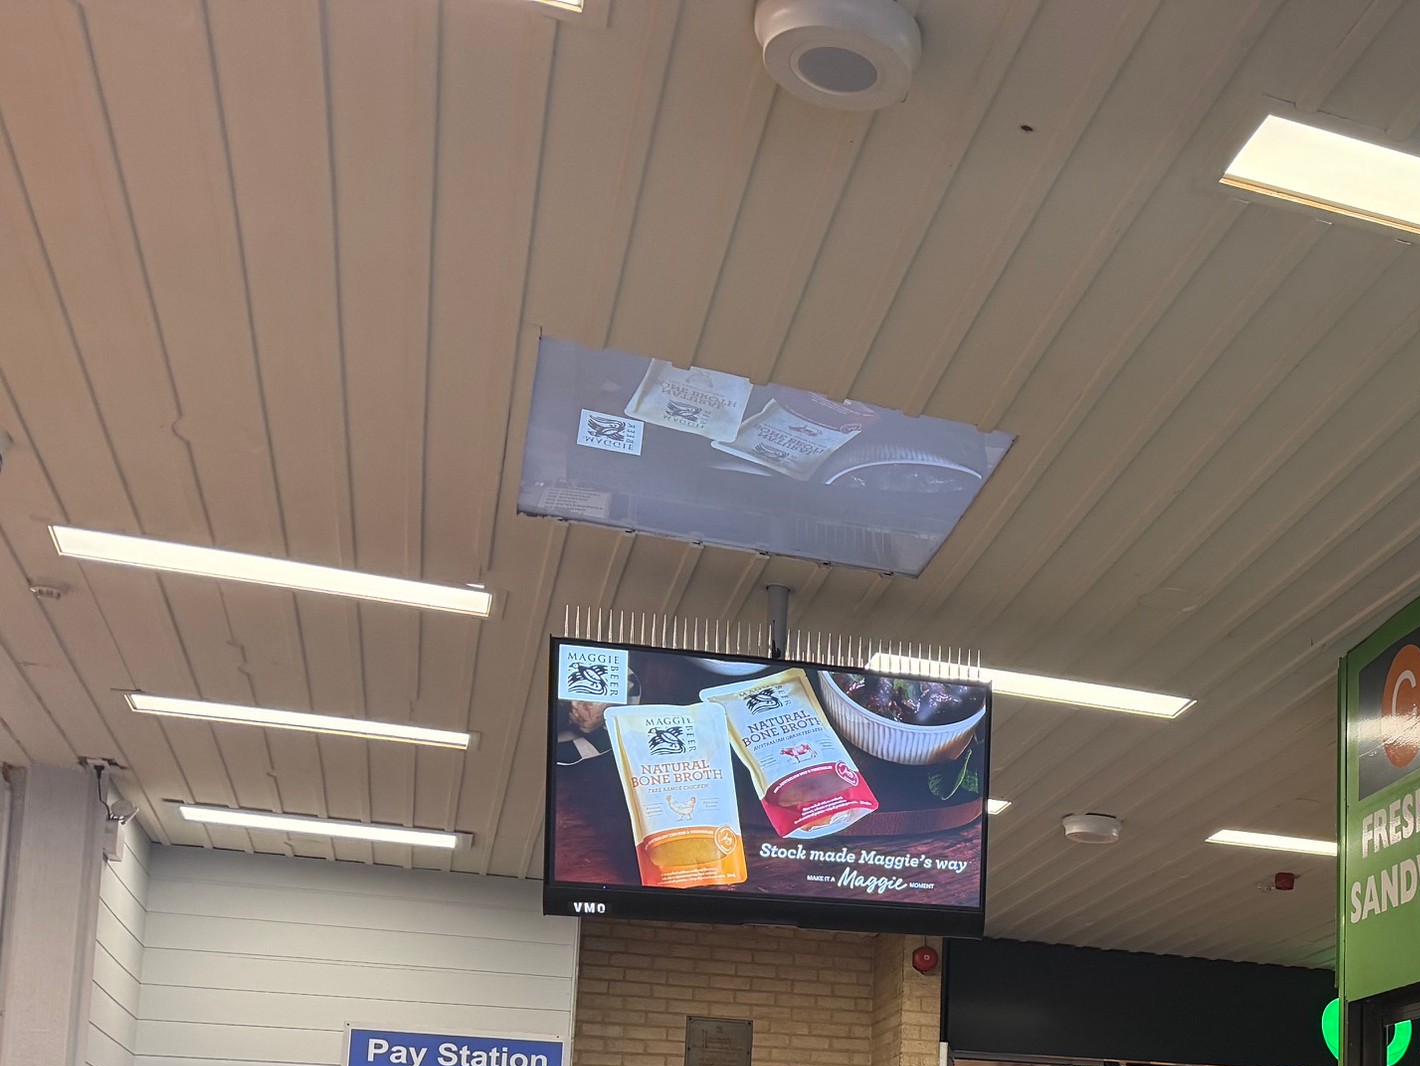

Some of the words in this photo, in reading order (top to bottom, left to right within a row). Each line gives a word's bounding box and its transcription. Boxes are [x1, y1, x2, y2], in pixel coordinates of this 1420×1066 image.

[567, 652, 619, 664] MAGGIE
[610, 665, 619, 696] BEER
[640, 759, 710, 775] NATURAL
[631, 774, 670, 788] BONE
[674, 769, 723, 783] BROTH
[760, 843, 806, 860] Stock
[810, 848, 856, 863] made
[858, 850, 932, 870] Maggie's
[936, 858, 968, 873] way
[837, 867, 907, 894] Maggie
[573, 901, 606, 914] VMO
